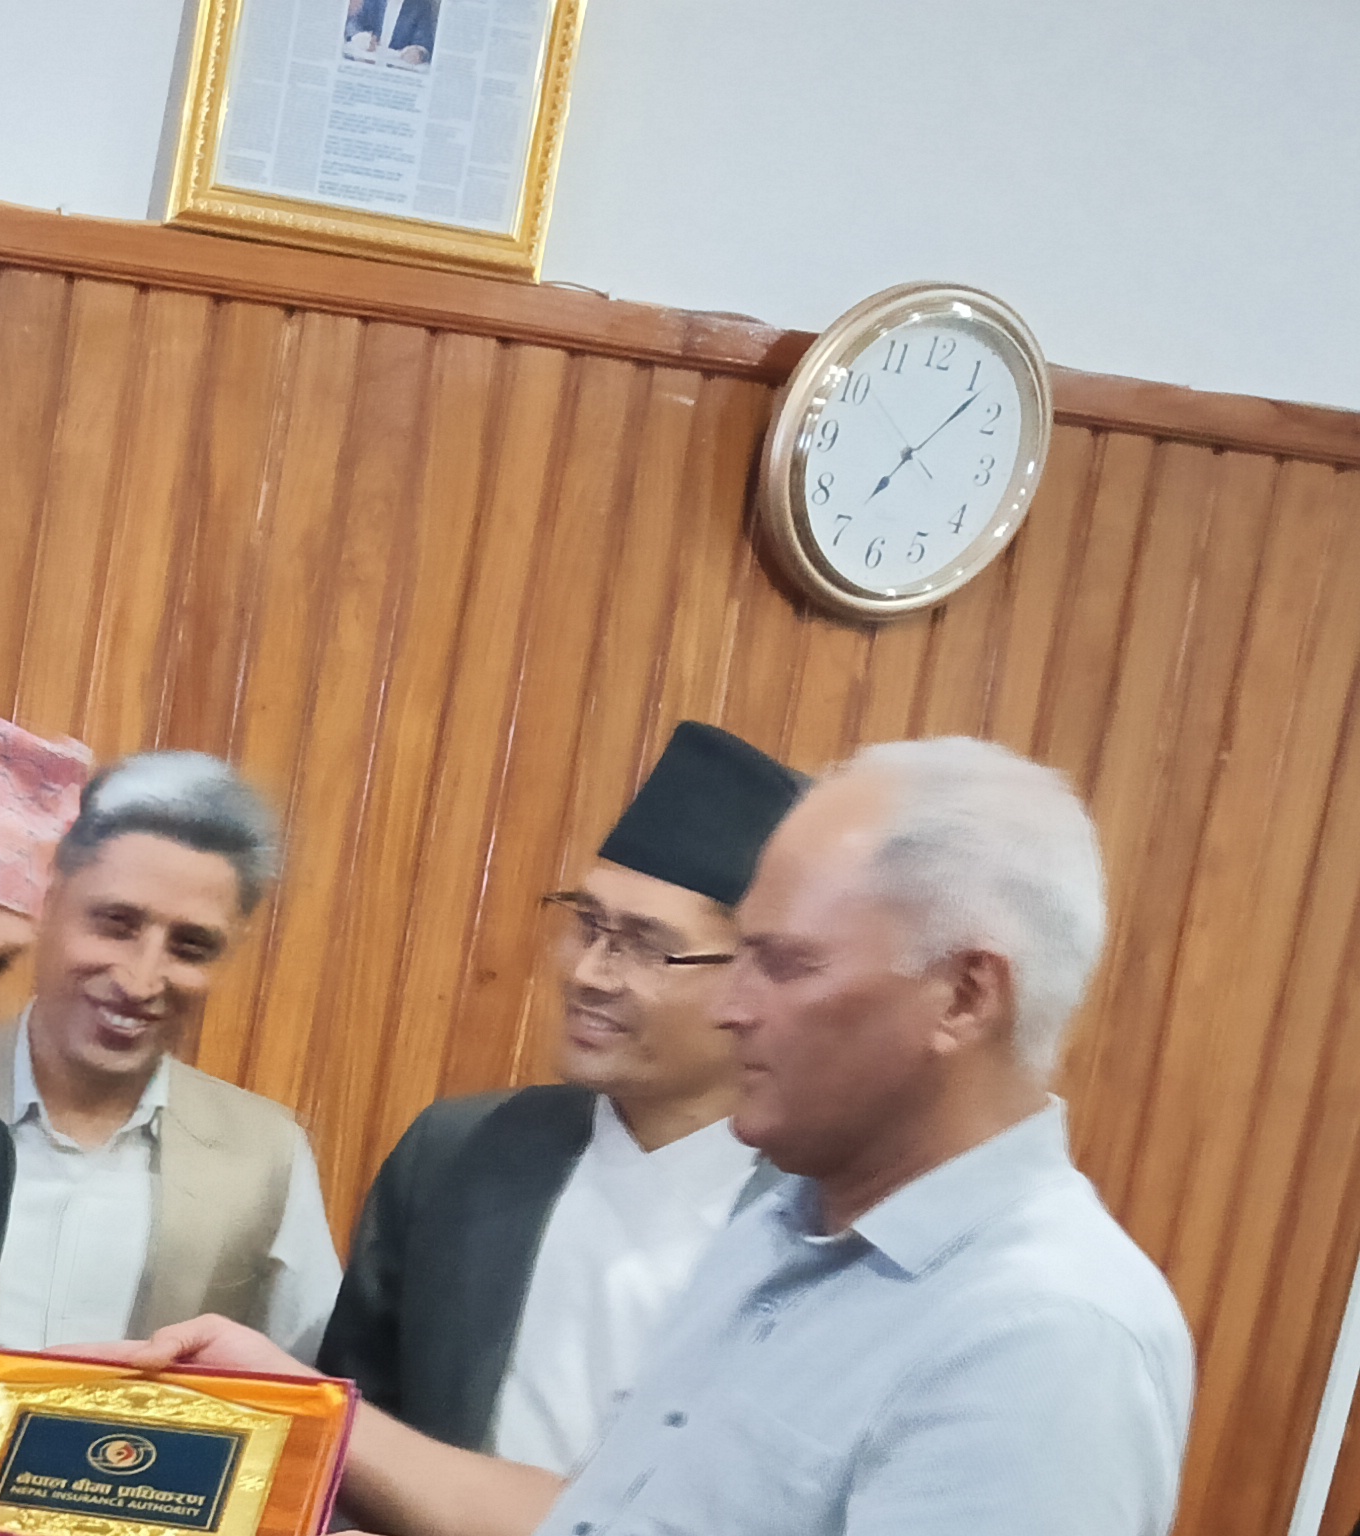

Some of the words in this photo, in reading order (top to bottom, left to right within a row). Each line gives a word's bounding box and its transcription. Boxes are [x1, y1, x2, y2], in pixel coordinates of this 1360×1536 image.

[882, 340, 909, 374] 11
[925, 336, 957, 371] 12
[840, 370, 871, 406] 10
[966, 360, 982, 391] 1
[816, 419, 839, 452] 9
[979, 402, 1002, 436] 2
[974, 454, 995, 487] 3
[811, 472, 835, 506] 8
[832, 513, 853, 547] 7
[947, 503, 967, 534] 4
[864, 536, 886, 569] 6
[906, 531, 929, 564] 5
[9, 1484, 48, 1498] NEPAL
[51, 1490, 125, 1508] INSURANCE
[127, 1500, 201, 1517] AUTHORITY
[16, 1471, 68, 1489] नेपाल
[72, 1477, 112, 1495] बीमा
[117, 1484, 206, 1507] प्राधिकरण
